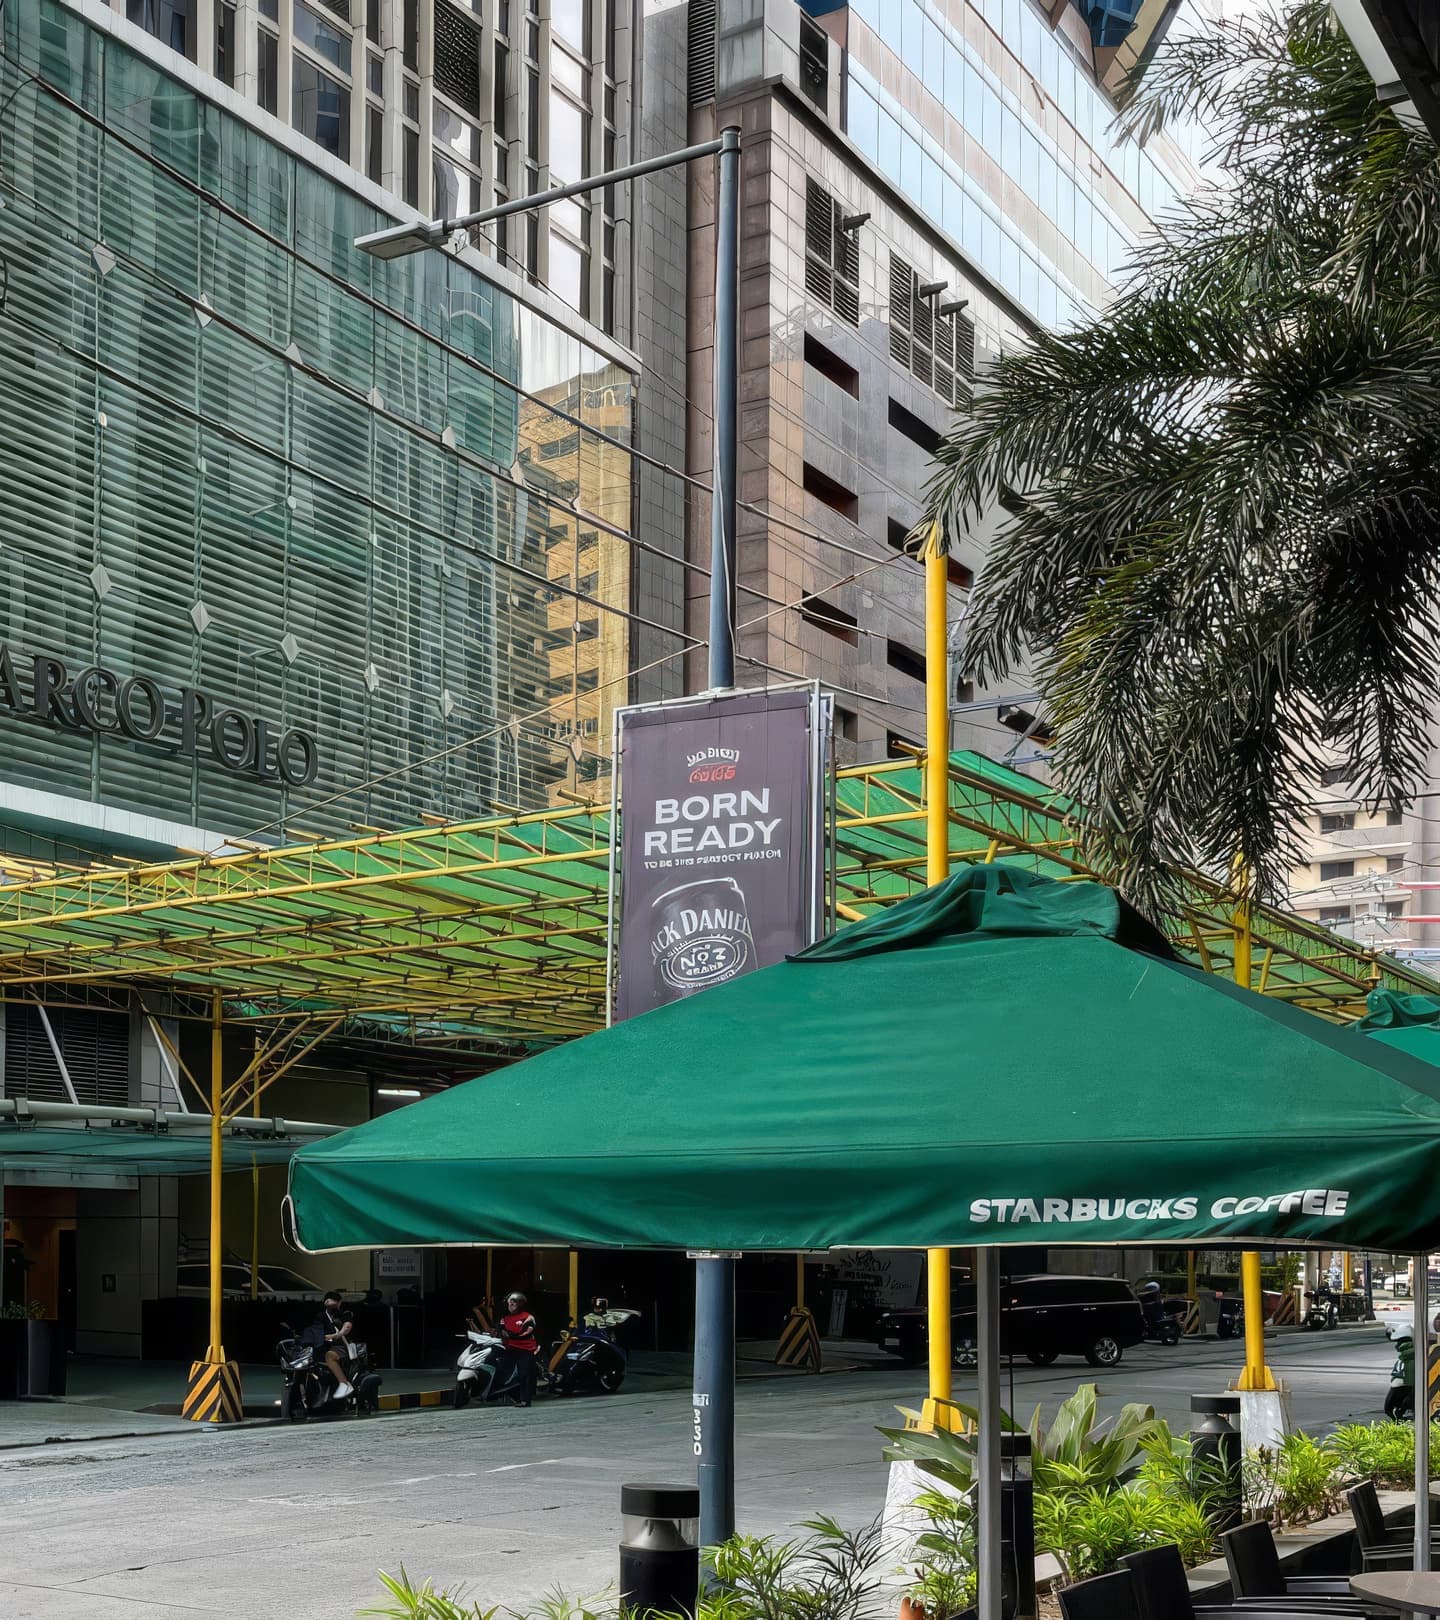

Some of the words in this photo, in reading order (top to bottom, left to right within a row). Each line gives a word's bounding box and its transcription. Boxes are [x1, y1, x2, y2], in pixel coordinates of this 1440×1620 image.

[178, 687, 319, 786] POLO
[655, 787, 770, 825] BORN
[644, 818, 782, 857] READY
[969, 1197, 1198, 1223] STARBUCKS
[1211, 1189, 1350, 1219] COFFEE
